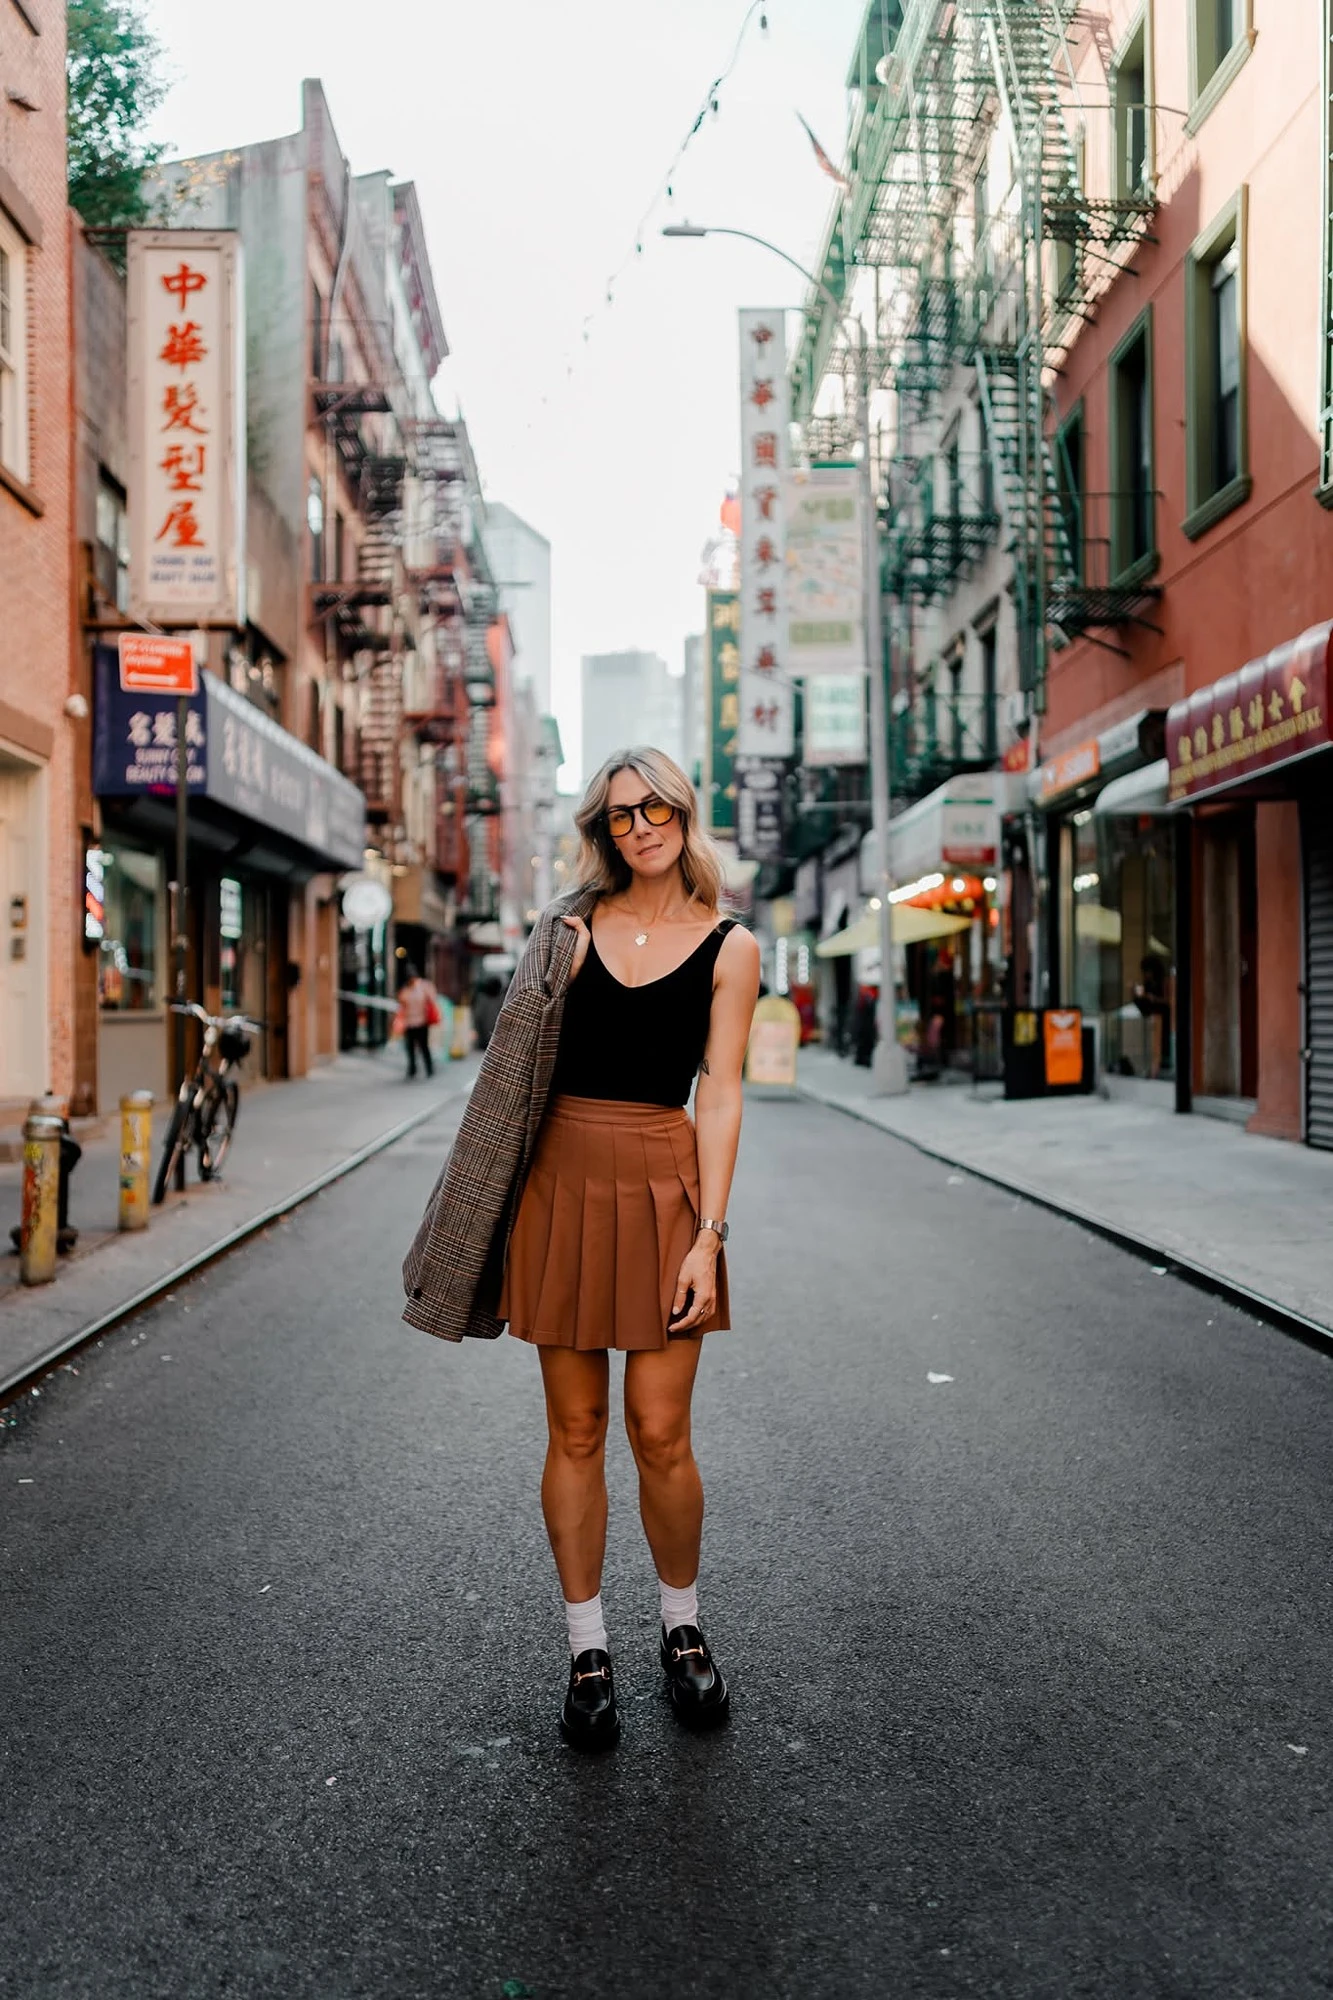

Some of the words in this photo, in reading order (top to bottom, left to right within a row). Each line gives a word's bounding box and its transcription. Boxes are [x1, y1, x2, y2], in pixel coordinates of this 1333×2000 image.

[155, 262, 209, 548] 中華髮型屋
[125, 764, 166, 784] BEAUTY
